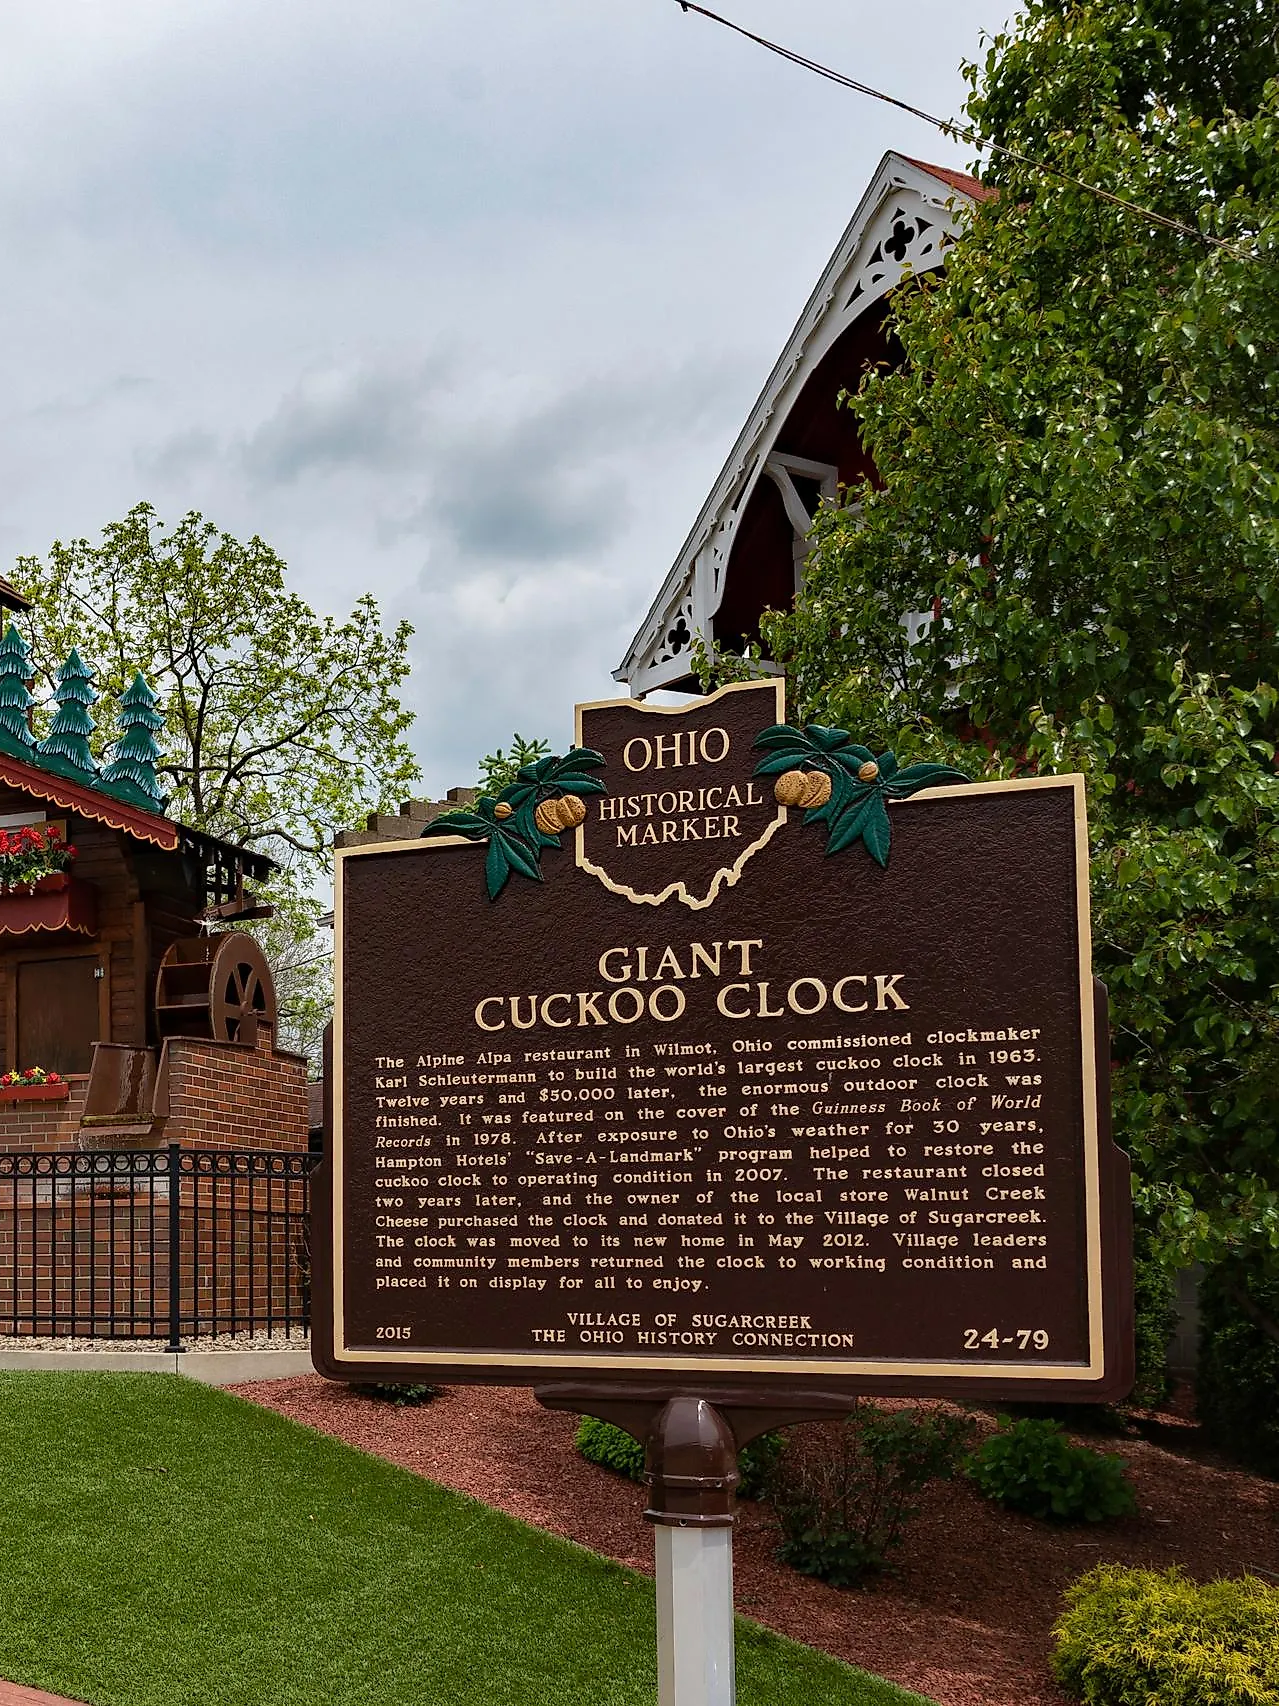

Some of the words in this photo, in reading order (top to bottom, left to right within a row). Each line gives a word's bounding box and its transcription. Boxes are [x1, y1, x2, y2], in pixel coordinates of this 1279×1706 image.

[624, 728, 730, 772] OHIO
[599, 783, 763, 821] HISTORICAL
[616, 815, 742, 847] MARKER
[598, 939, 762, 983] GIANT
[474, 985, 686, 1031] CUCKOO
[716, 974, 910, 1019] CLOCK
[374, 1057, 405, 1068] The
[415, 1054, 465, 1068] Alpine
[475, 1052, 513, 1065] Alpa
[523, 1047, 612, 1062] restaurant
[624, 1045, 641, 1057] in
[652, 1043, 718, 1056] Wilmot,
[731, 1039, 773, 1052] Ohio
[786, 1032, 913, 1050] commissioned
[926, 1027, 1041, 1044] clockmaker
[374, 1076, 408, 1088] Karl
[418, 1073, 537, 1086] Schleutermann
[547, 1070, 565, 1081] to
[574, 1067, 618, 1080] build
[627, 1066, 656, 1078] the
[663, 1061, 726, 1076] world's
[736, 1059, 804, 1076] largest
[815, 1056, 882, 1070] cuckoo
[892, 1053, 944, 1067] clock
[957, 1052, 977, 1065] in
[988, 1049, 1042, 1064] 1963.
[375, 1095, 430, 1108] Twelve
[439, 1095, 485, 1107] years
[498, 1092, 526, 1104] and
[538, 1088, 616, 1102] $50,000
[626, 1087, 676, 1099] later,
[697, 1084, 728, 1096] the
[741, 1083, 831, 1096] enormous
[843, 1079, 918, 1092] outdoor
[935, 1074, 990, 1088] clock
[1004, 1075, 1043, 1086] was
[374, 1115, 443, 1127] finished.
[458, 1113, 472, 1125] It
[481, 1114, 512, 1124] was
[521, 1110, 595, 1123] featured
[604, 1111, 625, 1120] on
[636, 1108, 665, 1119] the
[675, 1107, 727, 1118] cover
[739, 1103, 759, 1117] of
[769, 1104, 800, 1116] the
[811, 1101, 887, 1114] Guinness
[899, 1098, 942, 1112] Book
[956, 1097, 978, 1110] of
[990, 1094, 1043, 1109] World
[374, 1135, 432, 1148] Records
[445, 1135, 461, 1146] in
[473, 1132, 517, 1145] 1978.
[535, 1131, 583, 1143] After
[597, 1130, 678, 1143] exposure
[691, 1128, 710, 1139] to
[723, 1124, 777, 1138] Ohio's
[790, 1123, 870, 1137] weather
[884, 1122, 915, 1135] for
[932, 1120, 960, 1133] 30
[978, 1121, 1044, 1135] years,
[375, 1156, 443, 1170] Hampton
[455, 1152, 512, 1166] Hotels'
[717, 1149, 793, 1163] program
[809, 1145, 871, 1161] helped
[886, 1145, 907, 1157] to
[923, 1144, 994, 1156] restore
[1010, 1141, 1045, 1154] the
[374, 1175, 430, 1187] cuckoo
[437, 1174, 482, 1186] clock
[491, 1174, 508, 1185] to
[517, 1172, 599, 1187] operating
[612, 1170, 694, 1183] condition
[705, 1169, 723, 1182] in
[734, 1168, 788, 1181] 2007.
[812, 1167, 849, 1180] The
[861, 1165, 968, 1179] restaurant
[981, 1164, 1045, 1177] closed
[374, 1196, 404, 1207] two
[417, 1197, 462, 1208] years
[474, 1194, 522, 1207] later,
[542, 1194, 573, 1205] and
[584, 1193, 614, 1204] the
[626, 1194, 680, 1204] owner
[695, 1191, 715, 1203] of
[729, 1191, 760, 1203] the
[775, 1190, 823, 1203] local
[839, 1190, 889, 1201] store
[903, 1188, 969, 1201] Walnut
[985, 1186, 1046, 1200] Creek
[375, 1216, 429, 1227] Cheese
[437, 1215, 519, 1229] purchased
[527, 1215, 554, 1226] the
[562, 1214, 609, 1226] clock
[618, 1214, 649, 1225] and
[657, 1213, 724, 1225] donated
[733, 1213, 748, 1225] it
[756, 1213, 775, 1224] to
[784, 1212, 815, 1224] the
[823, 1211, 890, 1227] Village
[898, 1211, 918, 1224] of
[927, 1209, 1047, 1227] Sugarcreek.
[375, 1235, 405, 1247] The
[414, 1235, 457, 1247] clock
[465, 1238, 497, 1247] was
[509, 1235, 561, 1247] moved
[571, 1235, 589, 1247] to
[600, 1235, 621, 1247] its
[633, 1237, 668, 1247] new
[680, 1235, 726, 1247] home
[737, 1234, 755, 1246] in
[767, 1234, 805, 1249] May
[822, 1234, 870, 1246] 2012.
[891, 1233, 959, 1249] Village
[972, 1233, 1048, 1246] leaders
[375, 1256, 403, 1267] and
[412, 1256, 497, 1269] community
[506, 1255, 580, 1268] members
[590, 1256, 665, 1268] returned
[676, 1256, 706, 1268] the
[715, 1256, 766, 1268] clock
[777, 1256, 797, 1268] to
[808, 1255, 886, 1272] working
[901, 1256, 995, 1268] condition
[1011, 1256, 1048, 1269] and
[375, 1276, 427, 1289] placed
[437, 1276, 451, 1287] it
[459, 1279, 478, 1288] on
[488, 1276, 548, 1291] display
[558, 1276, 584, 1288] for
[594, 1276, 616, 1288] all
[625, 1277, 643, 1288] to
[652, 1277, 709, 1292] enjoy.
[375, 1326, 412, 1340] 2015
[567, 1312, 641, 1327] VILLAGE
[654, 1313, 677, 1328] OF
[691, 1314, 813, 1330] SUGARCREEK
[531, 1329, 566, 1343] THE
[579, 1330, 624, 1344] OHIO
[637, 1331, 717, 1346] HISTORY
[731, 1332, 855, 1348] CONNECTION
[963, 1327, 1050, 1350] 24-79
